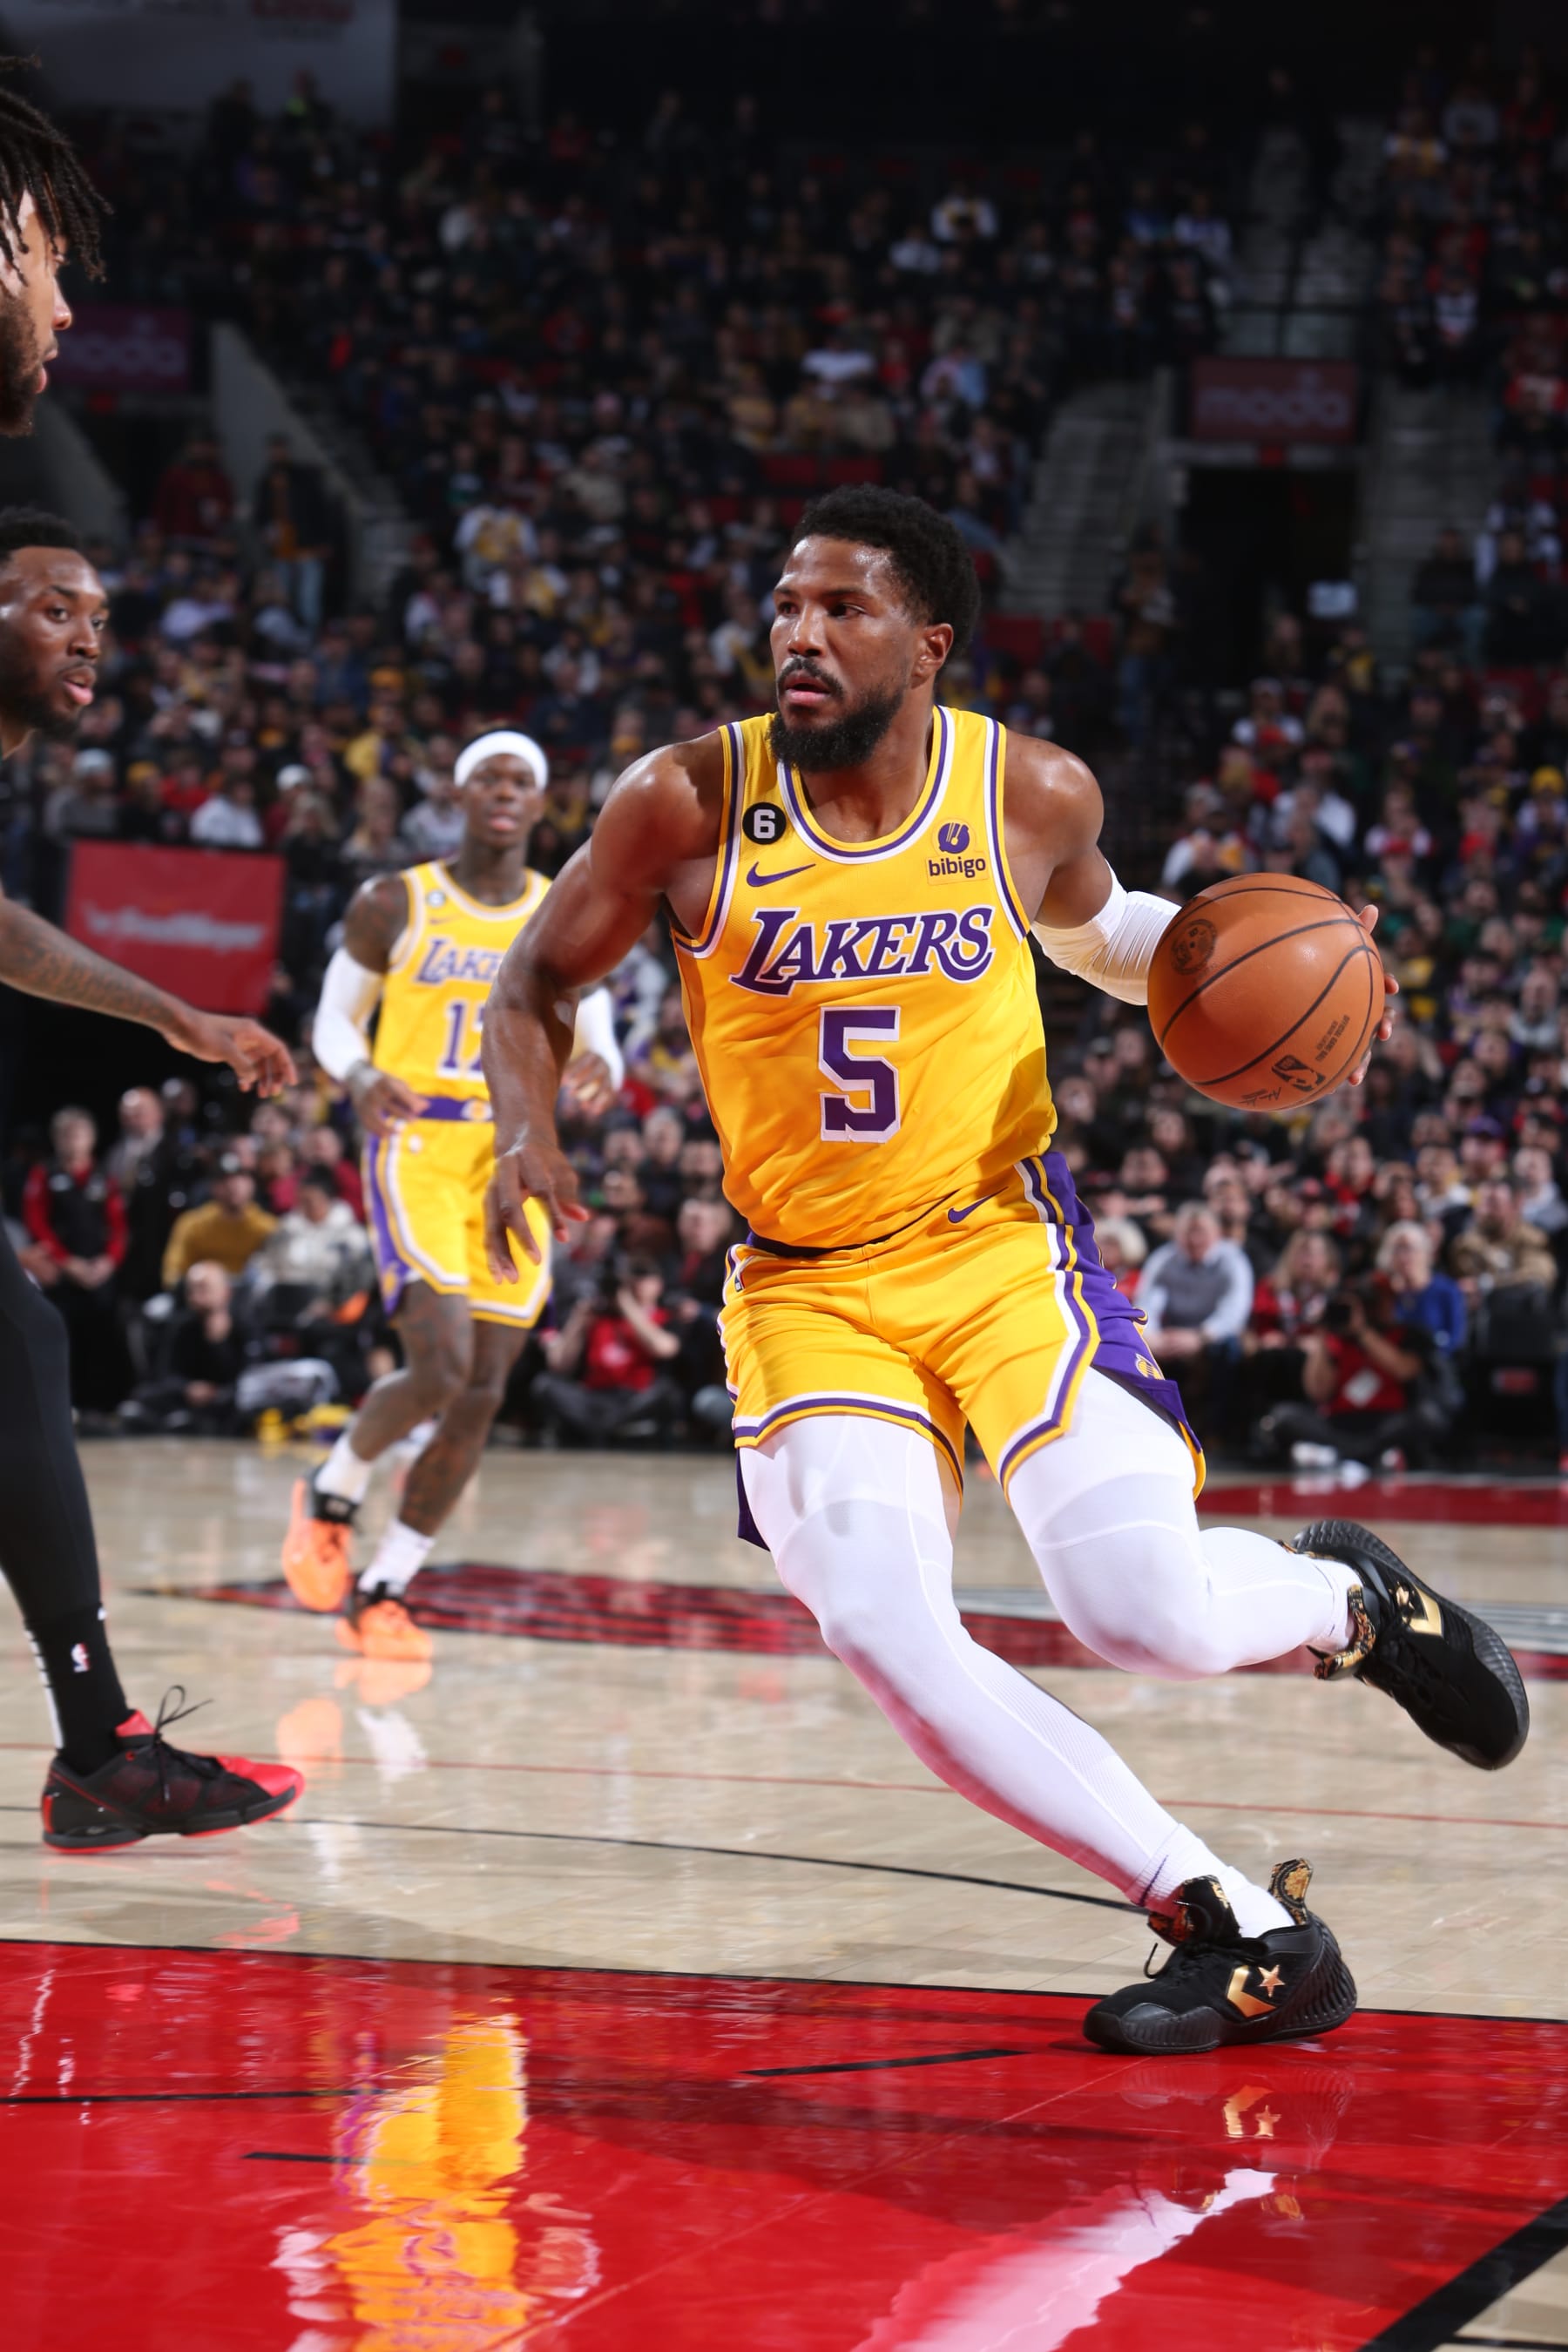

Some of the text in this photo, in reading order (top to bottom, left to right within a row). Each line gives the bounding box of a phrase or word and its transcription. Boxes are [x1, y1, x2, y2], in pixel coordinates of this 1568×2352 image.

[1195, 368, 1353, 429] moda
[754, 809, 775, 839] 6
[928, 856, 986, 878] bibigo
[413, 938, 505, 985] LAKE
[729, 905, 995, 997] LAKERS
[819, 1006, 901, 1143] 5
